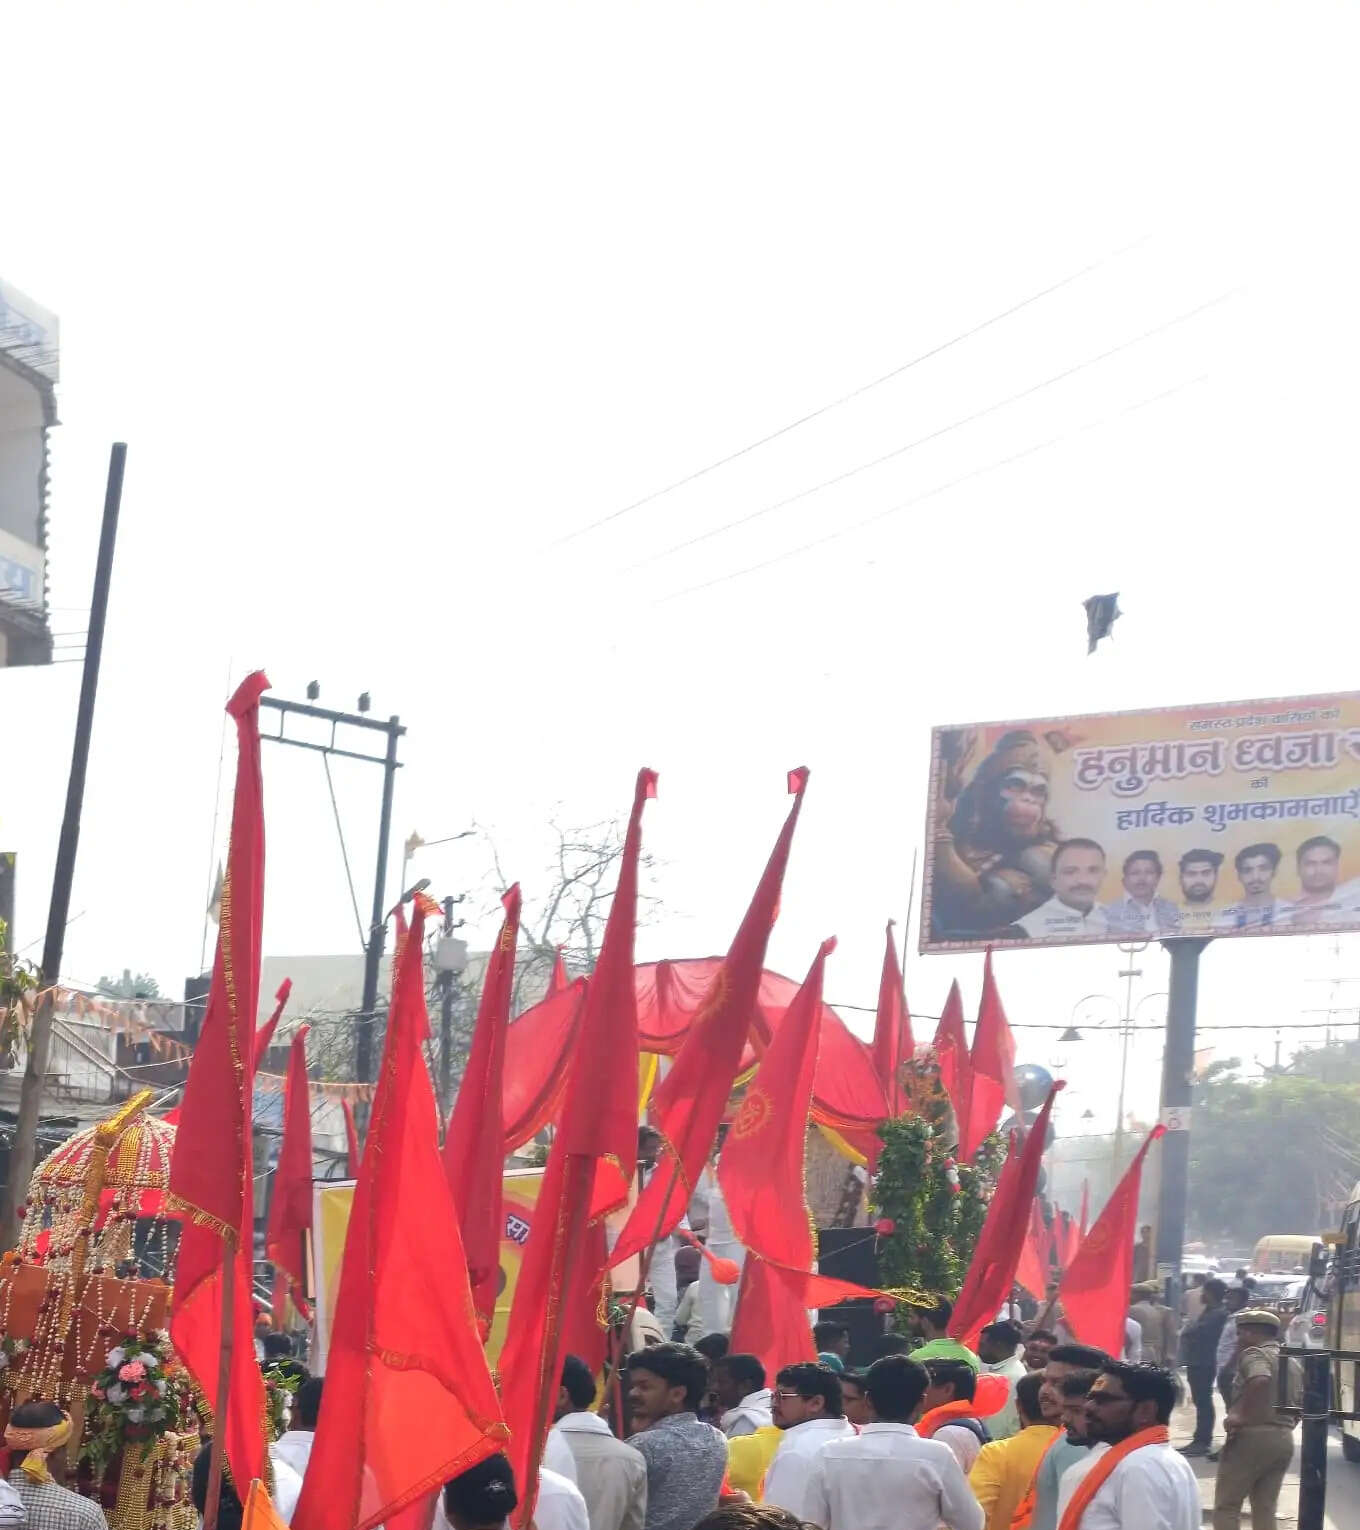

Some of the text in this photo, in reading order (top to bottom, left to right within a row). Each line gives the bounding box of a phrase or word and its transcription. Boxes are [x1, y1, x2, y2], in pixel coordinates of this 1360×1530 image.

[1077, 740, 1222, 791] हनुमान
[1235, 732, 1337, 766] ध्वजा
[1116, 801, 1196, 831] हार्दिक
